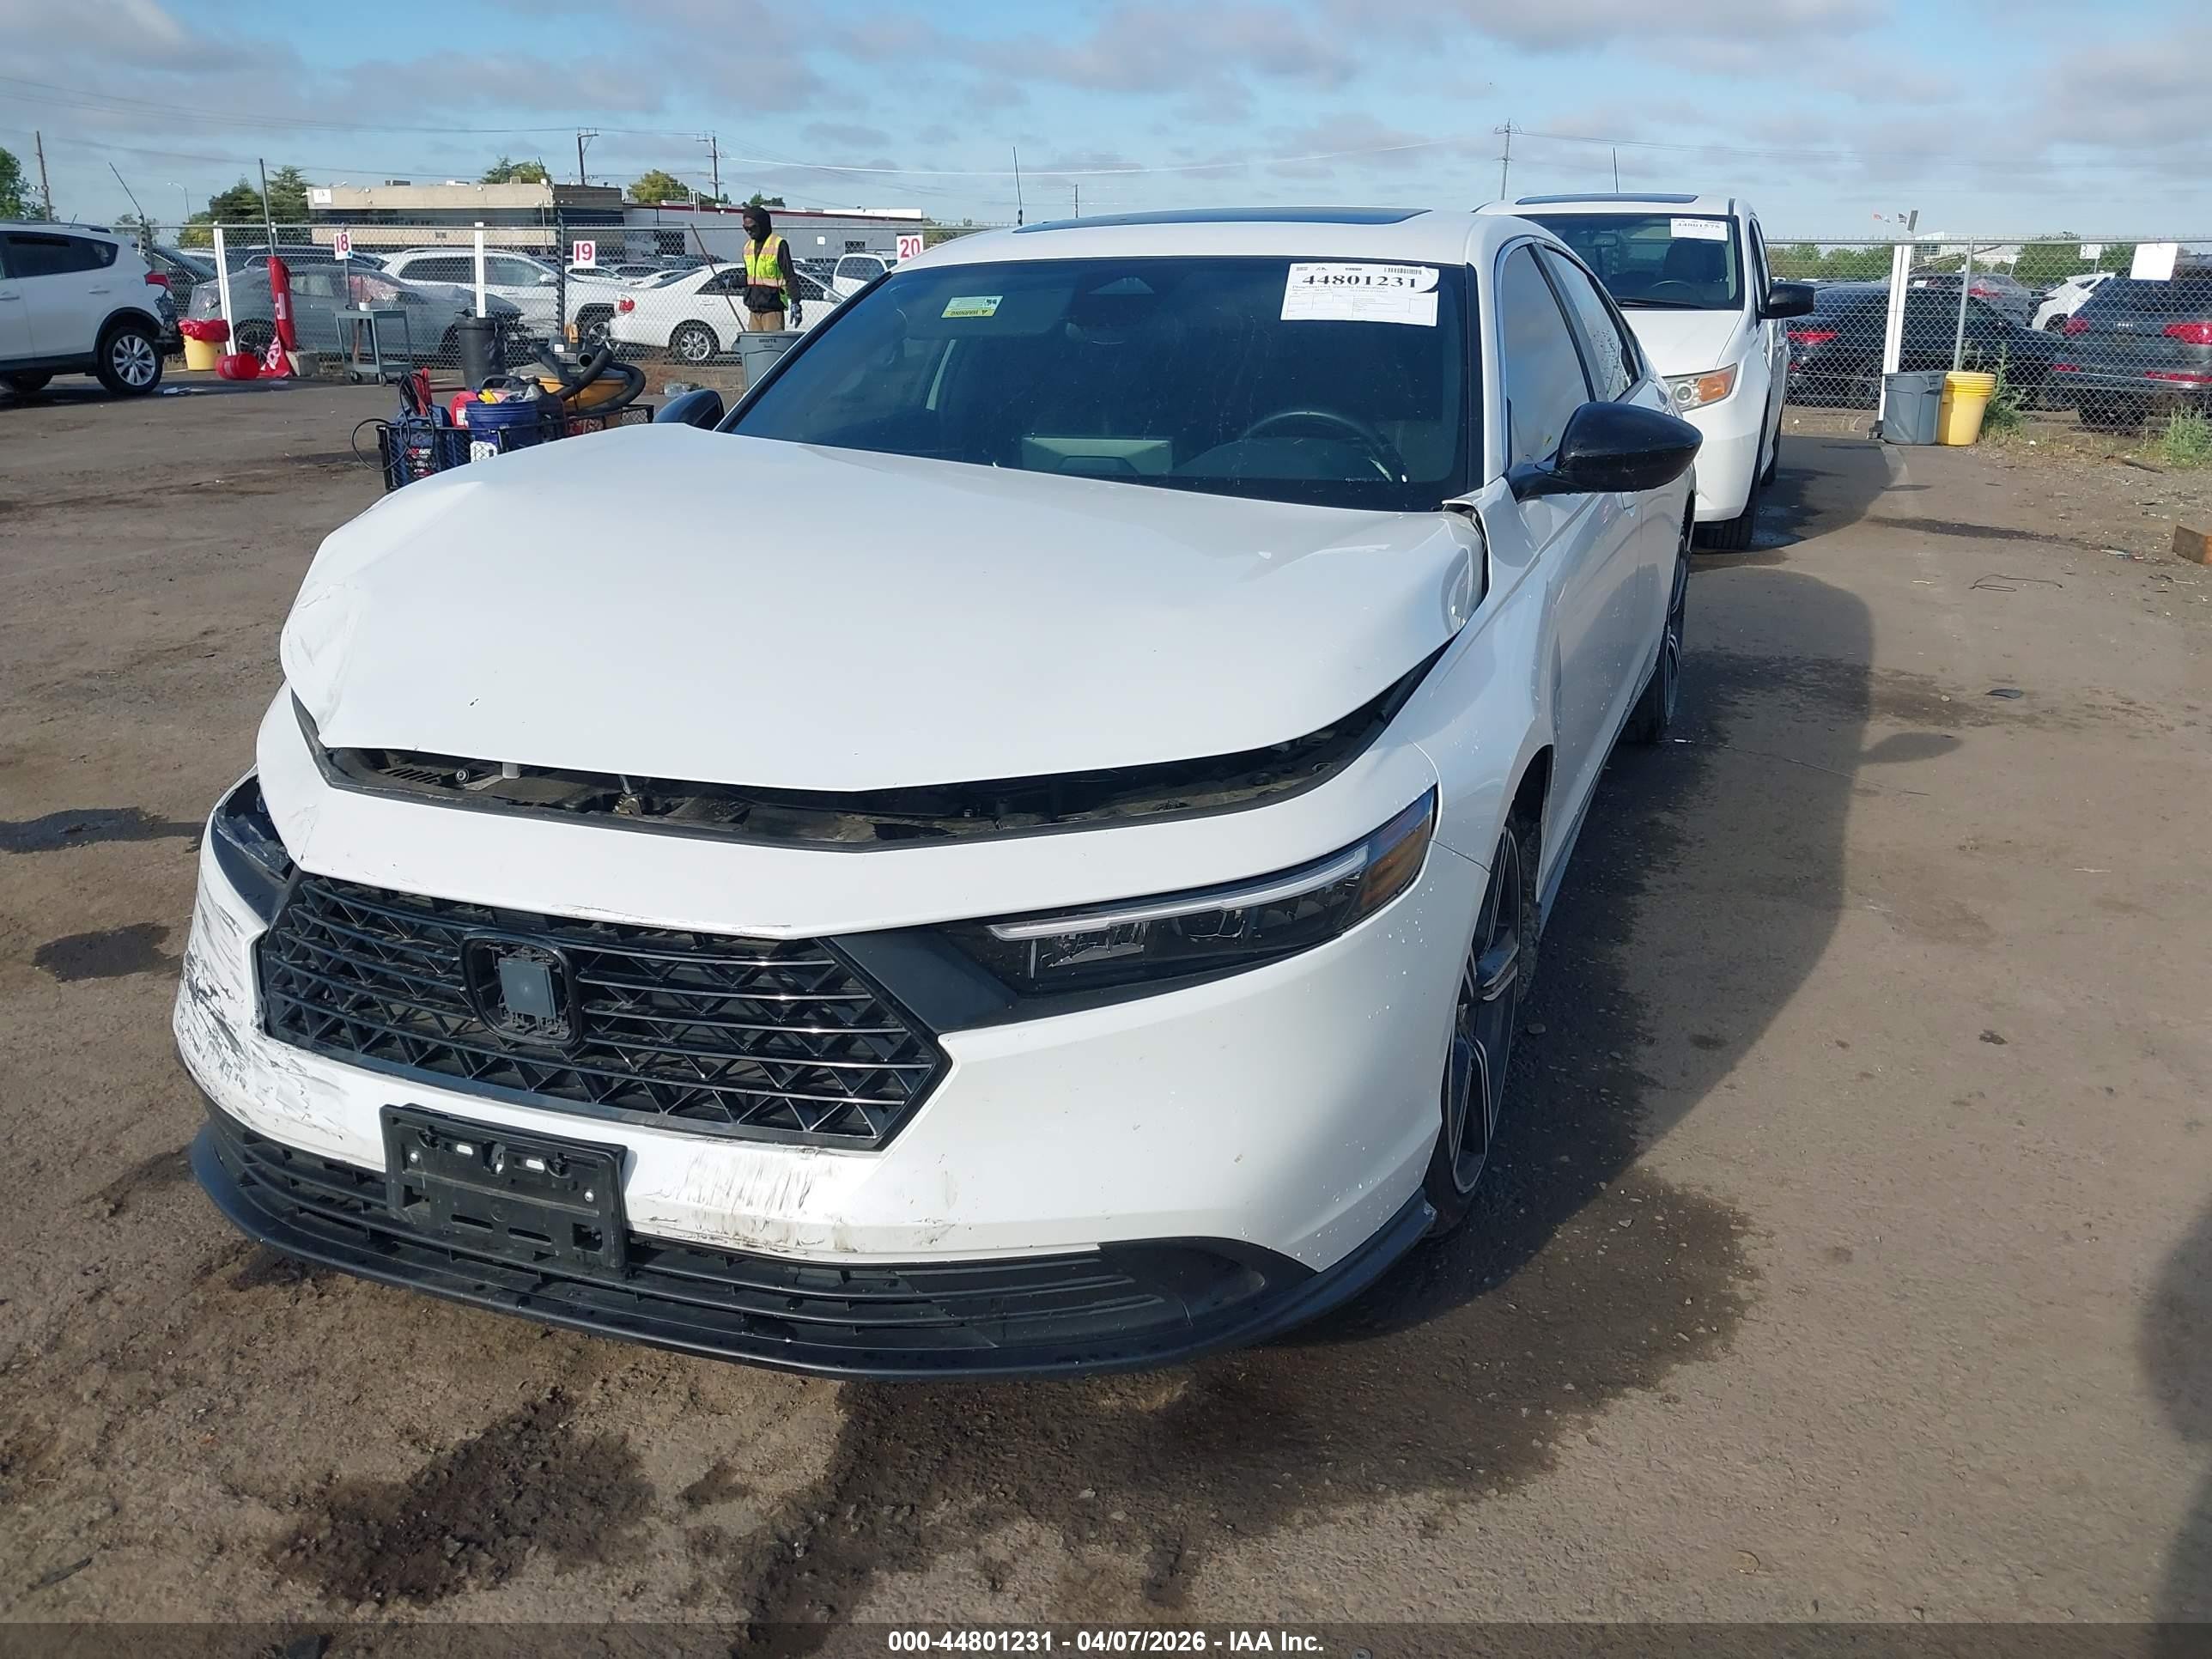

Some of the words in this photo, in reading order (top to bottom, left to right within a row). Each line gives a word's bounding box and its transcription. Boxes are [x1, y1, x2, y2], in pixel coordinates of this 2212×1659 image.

[336, 234, 349, 252] 18
[575, 242, 592, 261] 19
[900, 238, 921, 258] 20
[1302, 275, 1416, 289] 44801231
